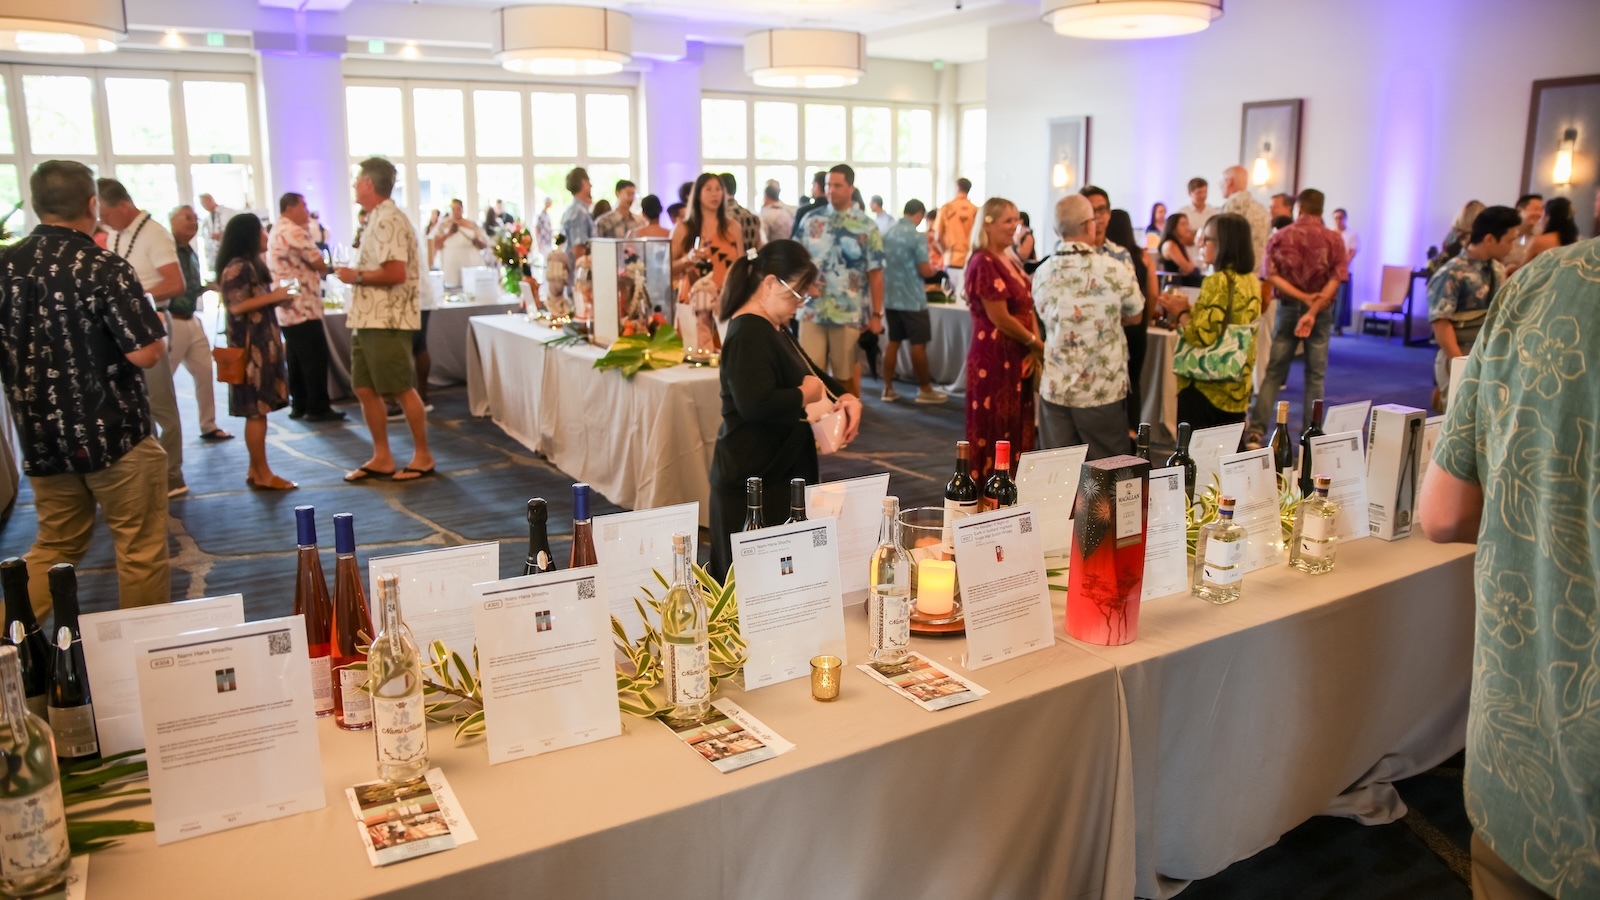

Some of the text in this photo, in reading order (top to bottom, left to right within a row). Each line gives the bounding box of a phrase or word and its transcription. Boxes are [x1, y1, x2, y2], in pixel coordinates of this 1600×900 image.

[1118, 494, 1140, 502] MACALLAN
[388, 604, 396, 612] 24
[211, 646, 233, 654] Shochu
[682, 668, 700, 676] Nami
[404, 722, 422, 733] Hana
[5, 826, 37, 842] Nami
